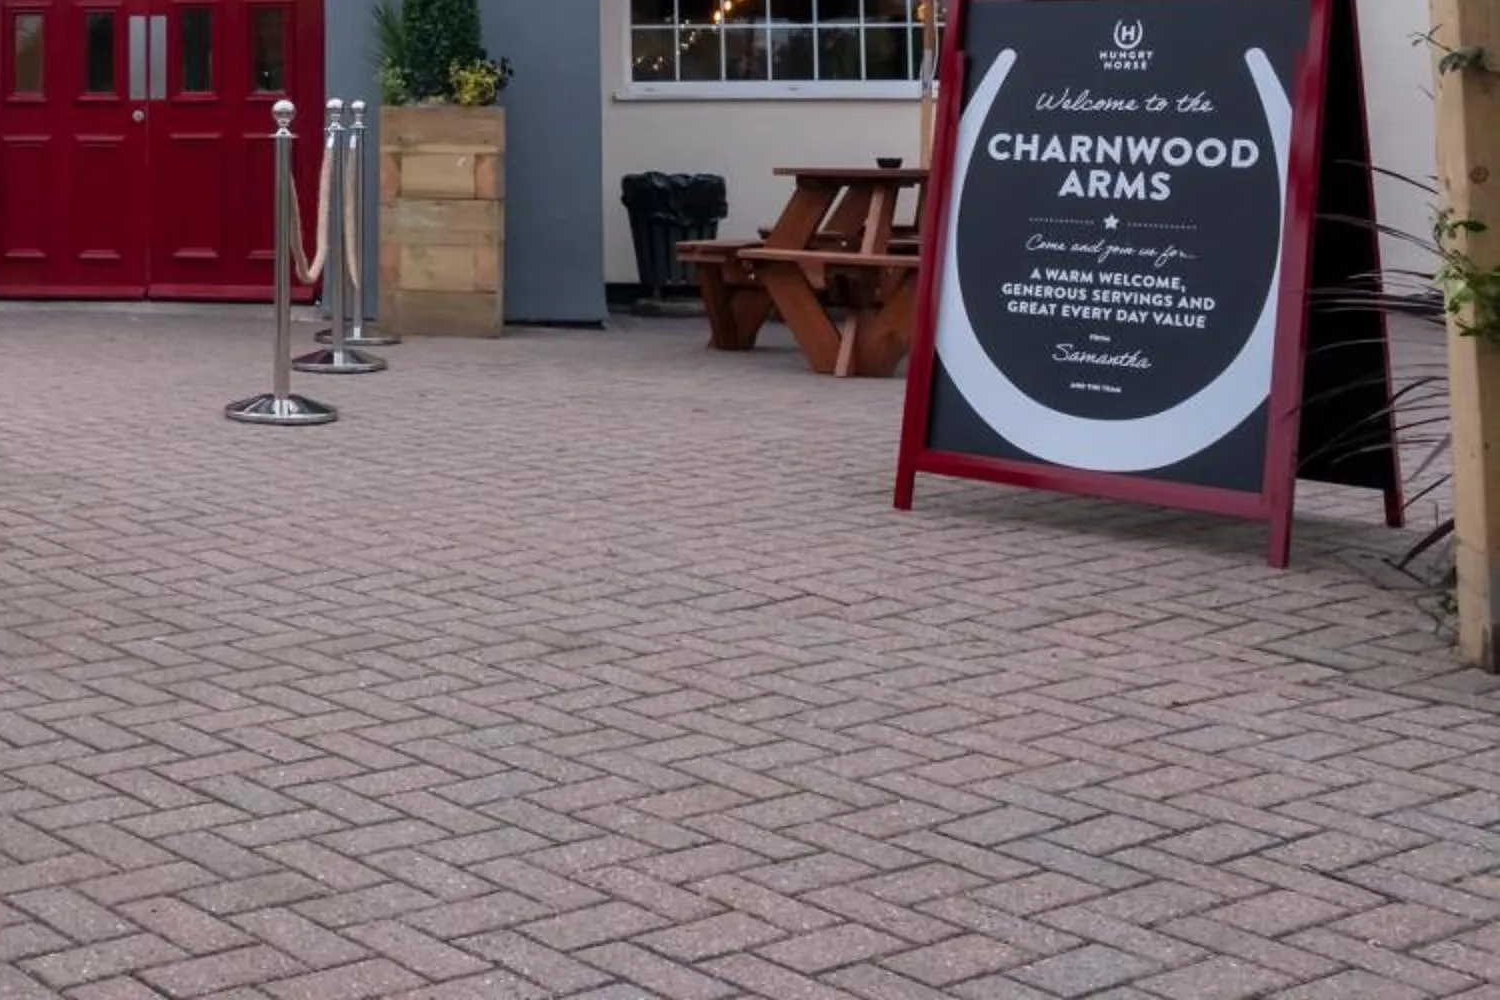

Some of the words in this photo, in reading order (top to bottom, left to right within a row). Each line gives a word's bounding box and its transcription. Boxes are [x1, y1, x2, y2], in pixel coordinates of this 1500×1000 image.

[1035, 88, 1140, 112] Welcome
[1145, 94, 1169, 112] to
[1175, 90, 1215, 113] the
[987, 133, 1259, 168] CHARNWOOD
[1057, 169, 1173, 201] ARMS
[1025, 233, 1066, 251] Come
[1070, 240, 1105, 252] and
[1030, 267, 1042, 280] A
[1045, 268, 1094, 284] WARM
[1099, 271, 1186, 293] WELCOME,
[1002, 283, 1087, 301] GENEROUS
[1092, 289, 1173, 308] SERVINGS
[1177, 297, 1216, 311] AND
[1007, 300, 1057, 316] GREAT
[1061, 305, 1113, 320] EVERY
[1115, 309, 1149, 324] DAY
[1152, 312, 1207, 329] VALUE
[1051, 343, 1152, 369] Samantha
